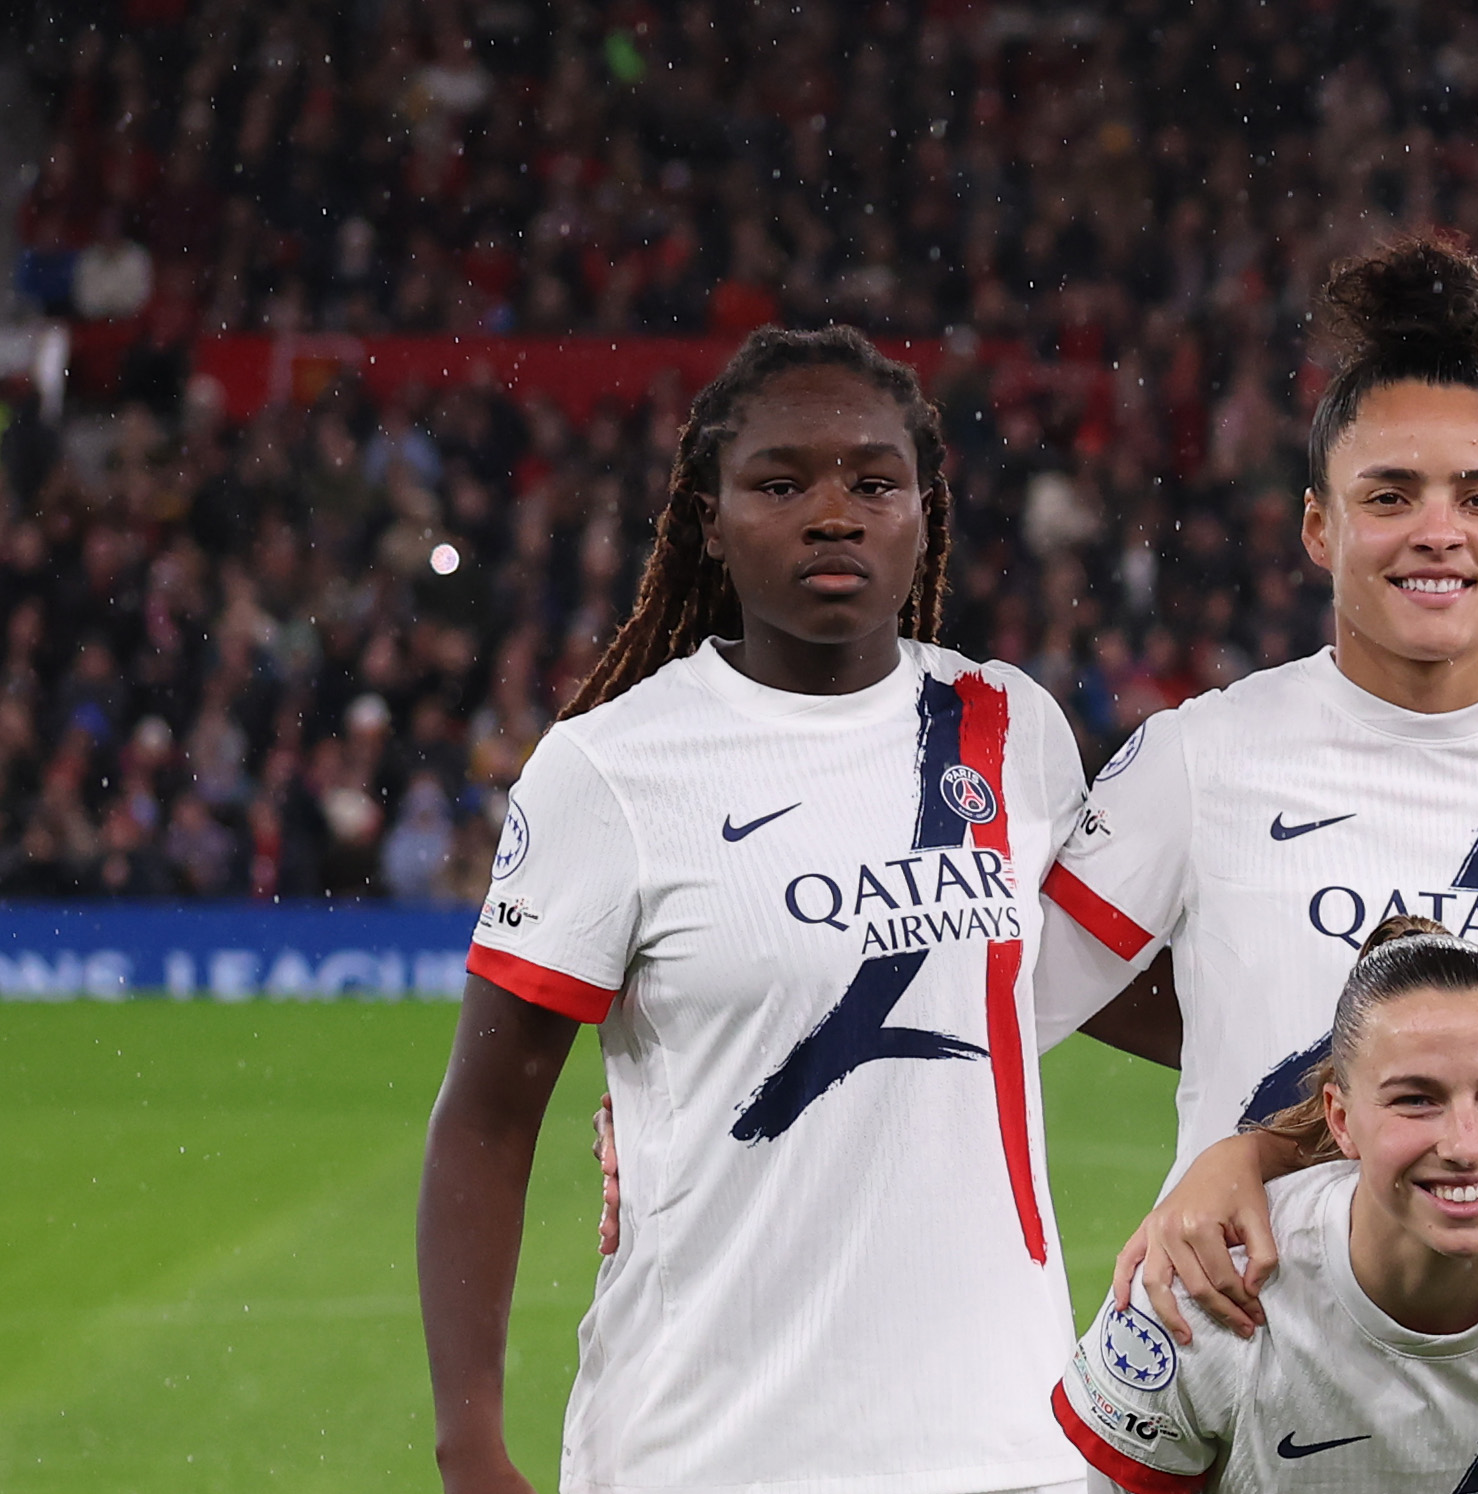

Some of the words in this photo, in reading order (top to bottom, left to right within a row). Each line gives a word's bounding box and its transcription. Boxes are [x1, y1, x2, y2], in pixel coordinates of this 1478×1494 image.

[946, 769, 979, 784] PARIS
[785, 850, 1014, 932] QATAR
[498, 902, 522, 927] 10
[861, 907, 1021, 954] AIRWAYS
[1125, 1413, 1158, 1440] 10
